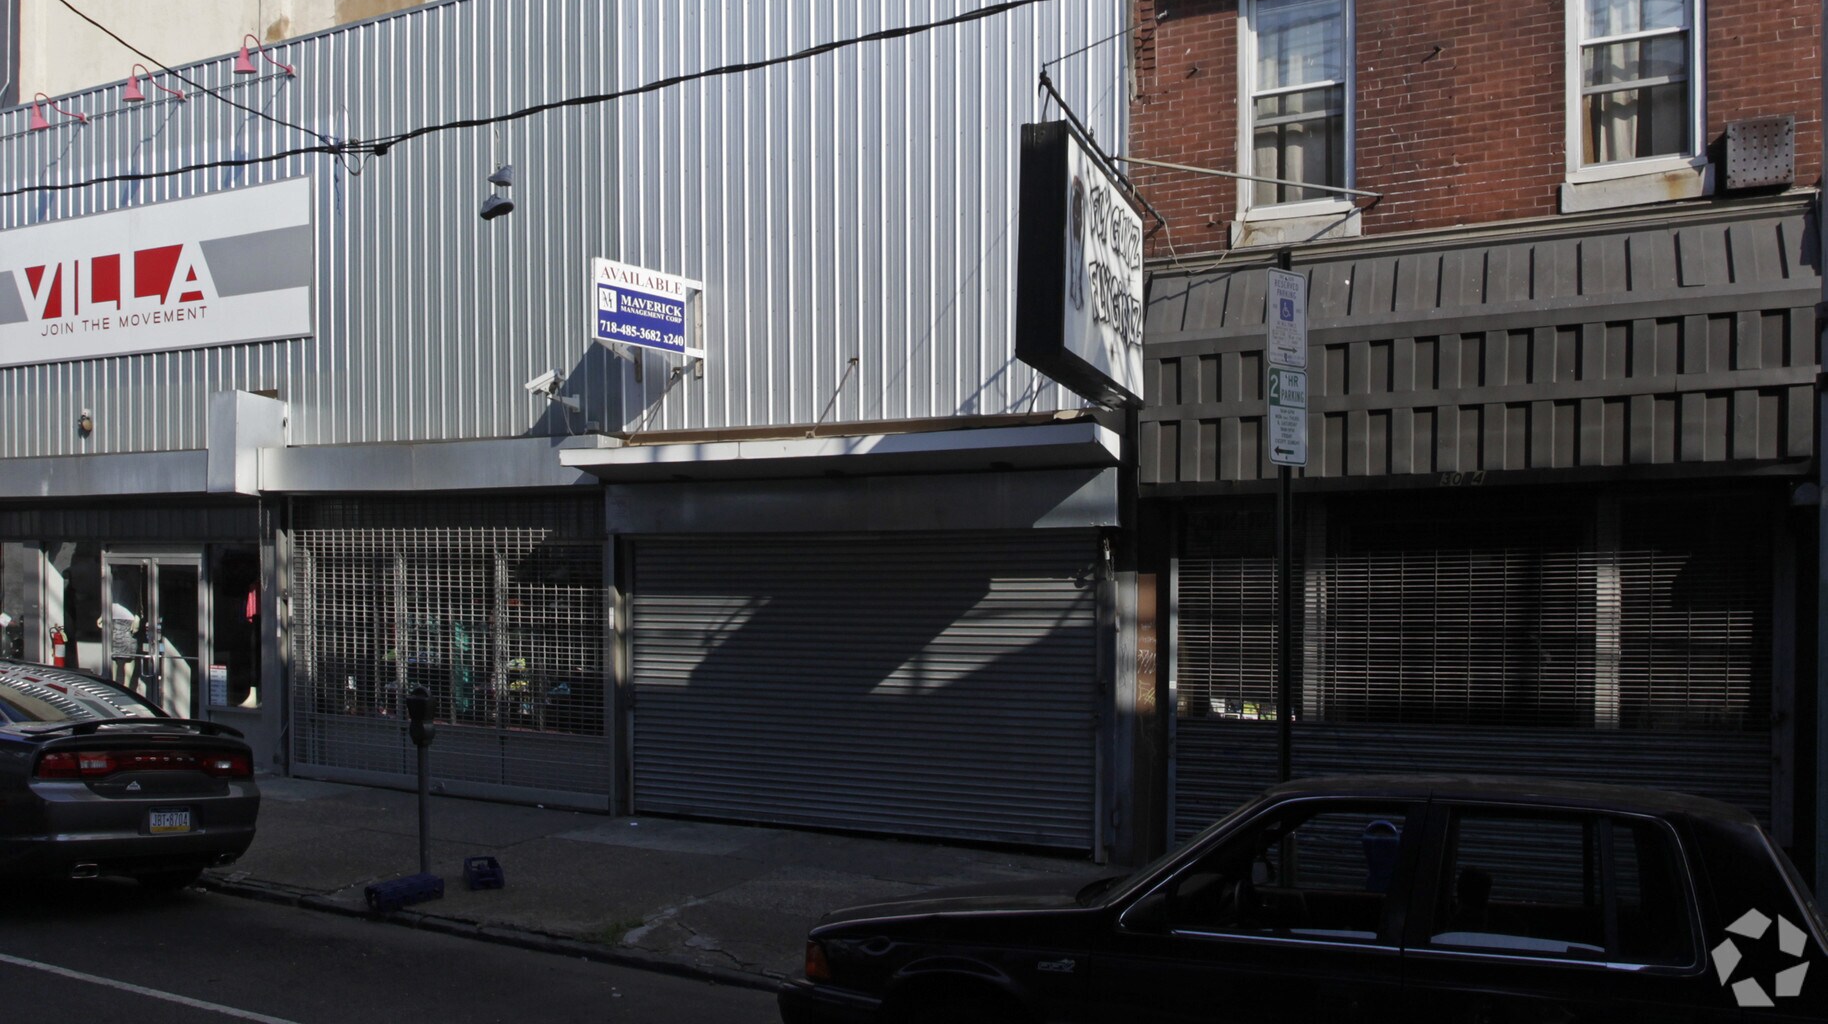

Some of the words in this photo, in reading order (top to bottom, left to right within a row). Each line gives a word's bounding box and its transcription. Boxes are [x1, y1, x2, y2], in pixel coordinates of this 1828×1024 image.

[1089, 187, 1110, 243] FLY
[1110, 205, 1141, 269] GUYZ
[13, 244, 219, 320] VILLA
[601, 266, 683, 296] AVAILABLE
[1089, 260, 1110, 322] FLY
[1274, 279, 1299, 291] RESERVED
[1277, 288, 1296, 299] PARKING
[620, 305, 665, 320] MANAGEMENT
[665, 315, 682, 324] CORP
[621, 294, 682, 318] MAVERICK
[41, 321, 74, 337] JOIN
[82, 317, 111, 331] THE
[119, 305, 208, 328] MOVEMENT
[600, 319, 661, 342] 718-485-3682
[663, 333, 684, 347] x240
[1270, 374, 1278, 398] 2
[1288, 375, 1299, 387] HR
[1281, 389, 1304, 403] PARKING
